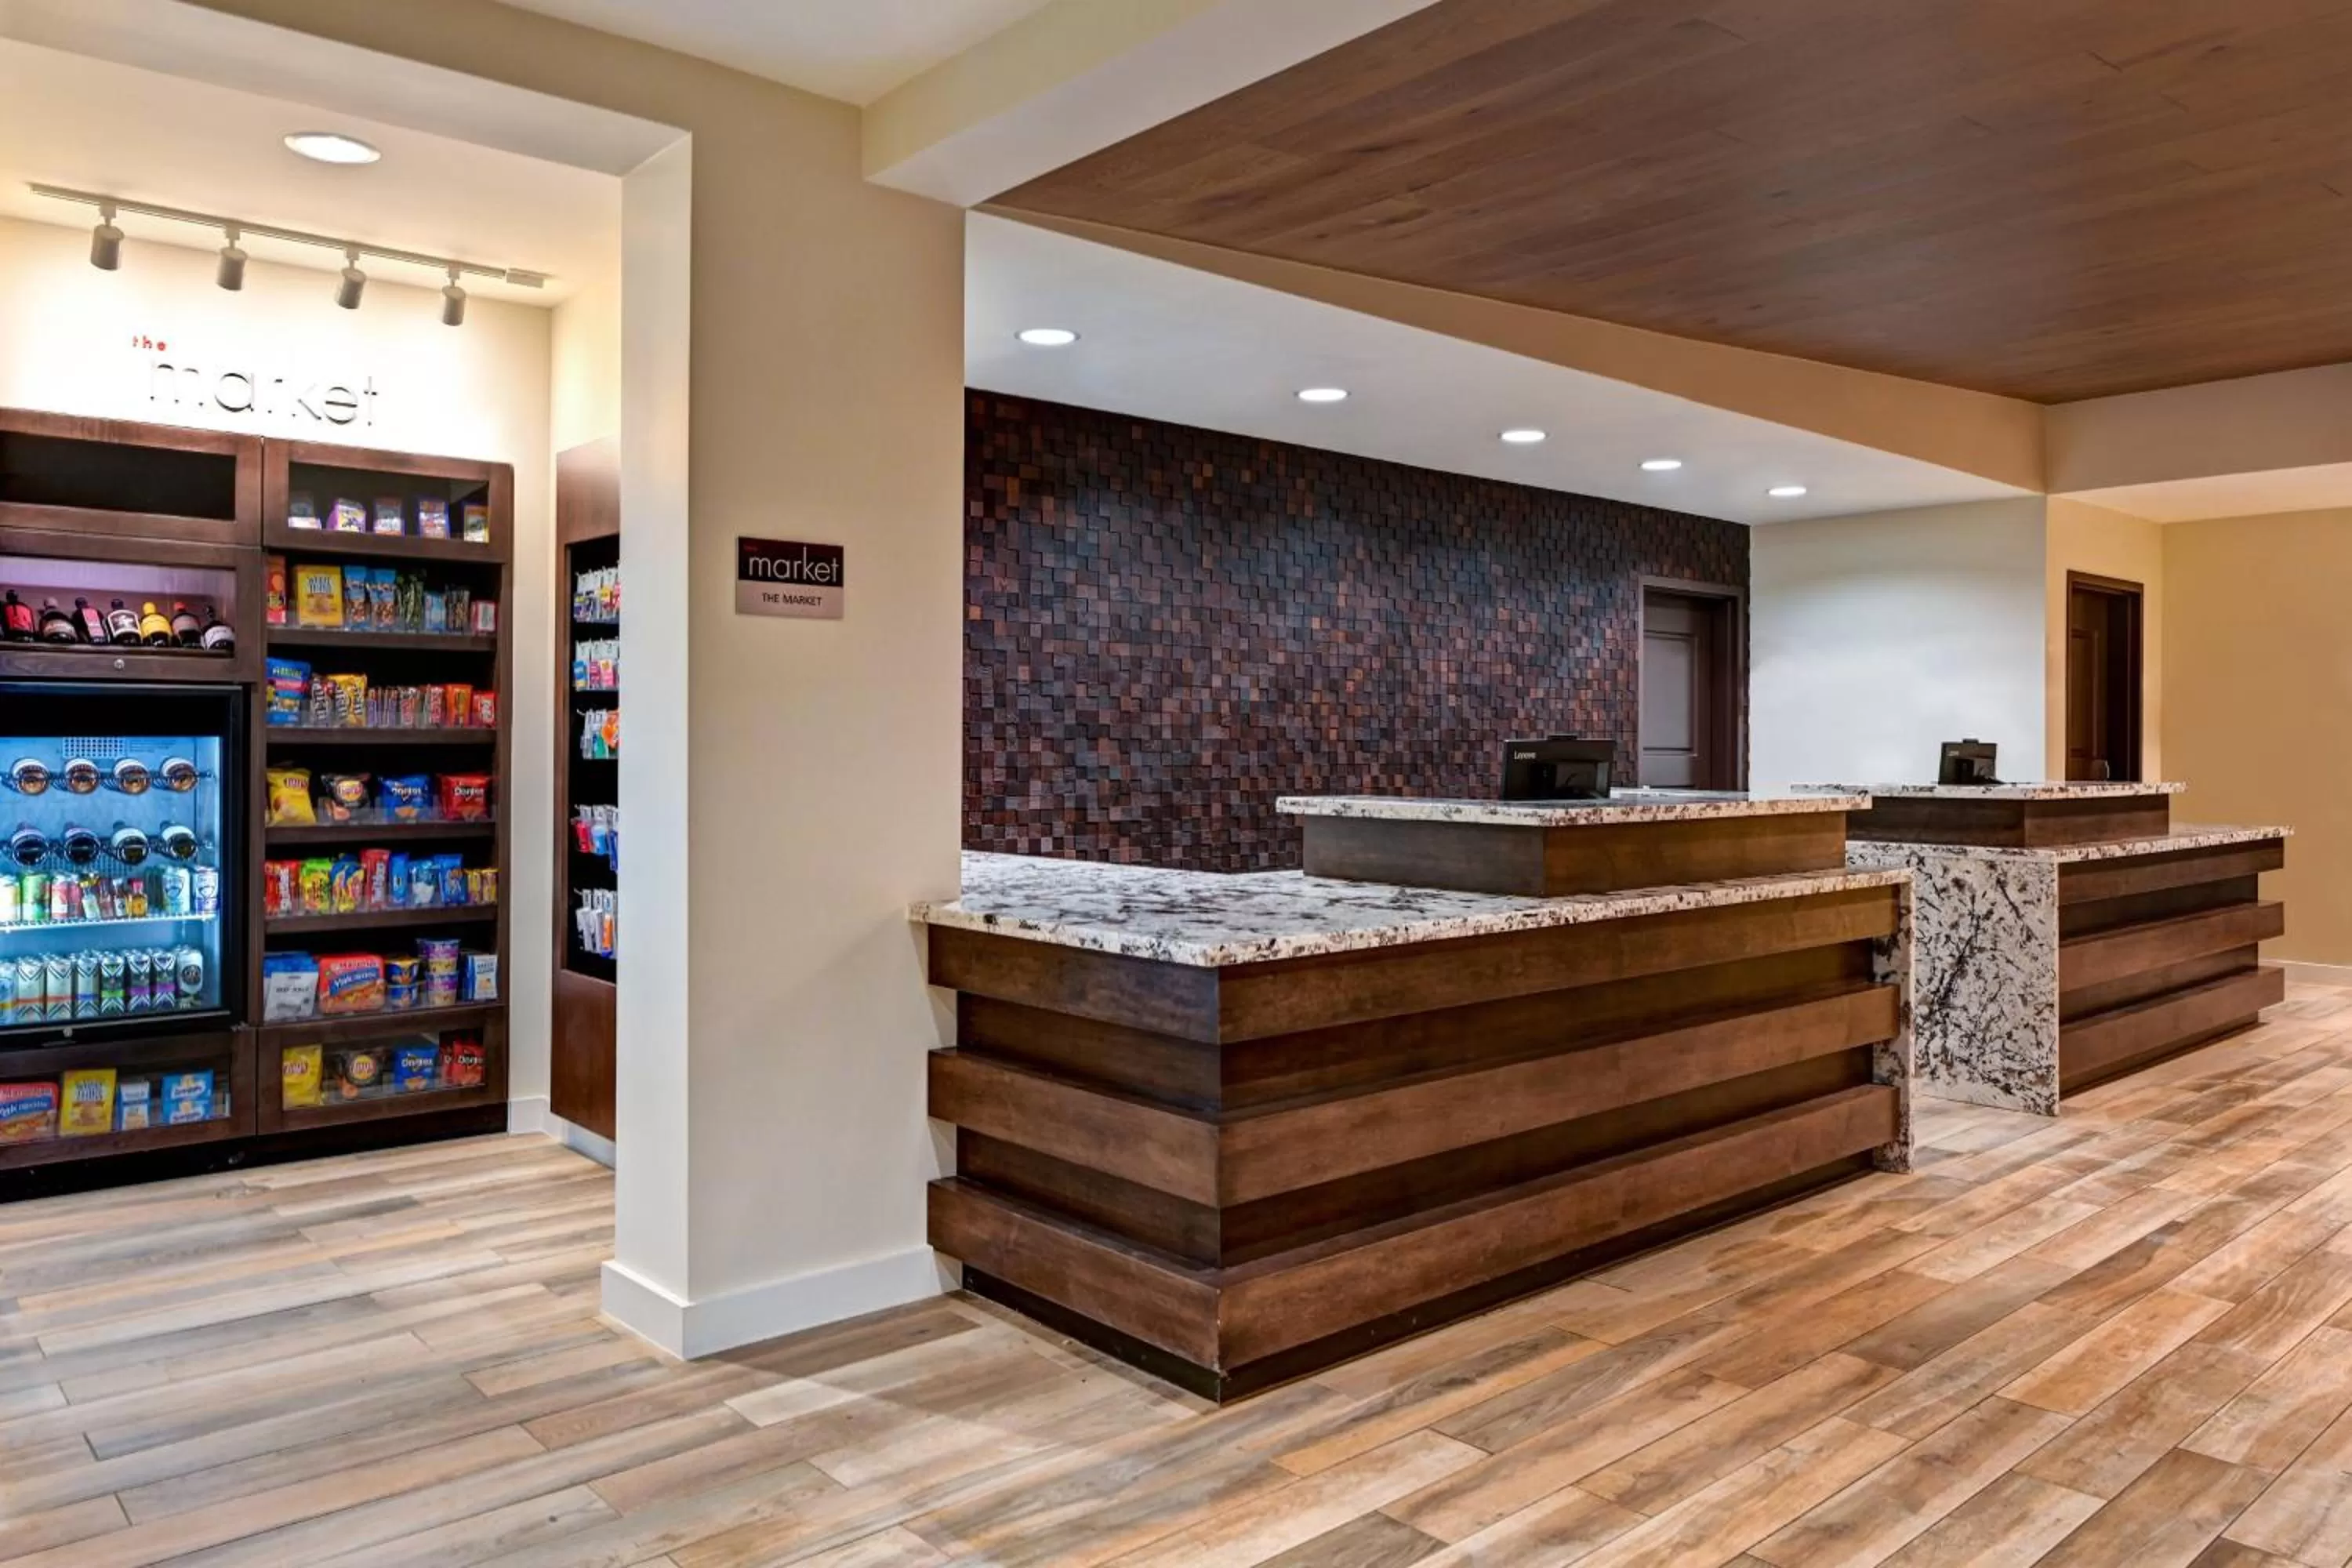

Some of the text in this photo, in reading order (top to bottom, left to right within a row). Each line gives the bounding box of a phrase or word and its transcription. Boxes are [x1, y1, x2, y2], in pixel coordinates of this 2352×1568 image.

[132, 335, 166, 351] the
[150, 357, 379, 427] market
[749, 546, 840, 583] market
[762, 592, 822, 606] THE MARKET
